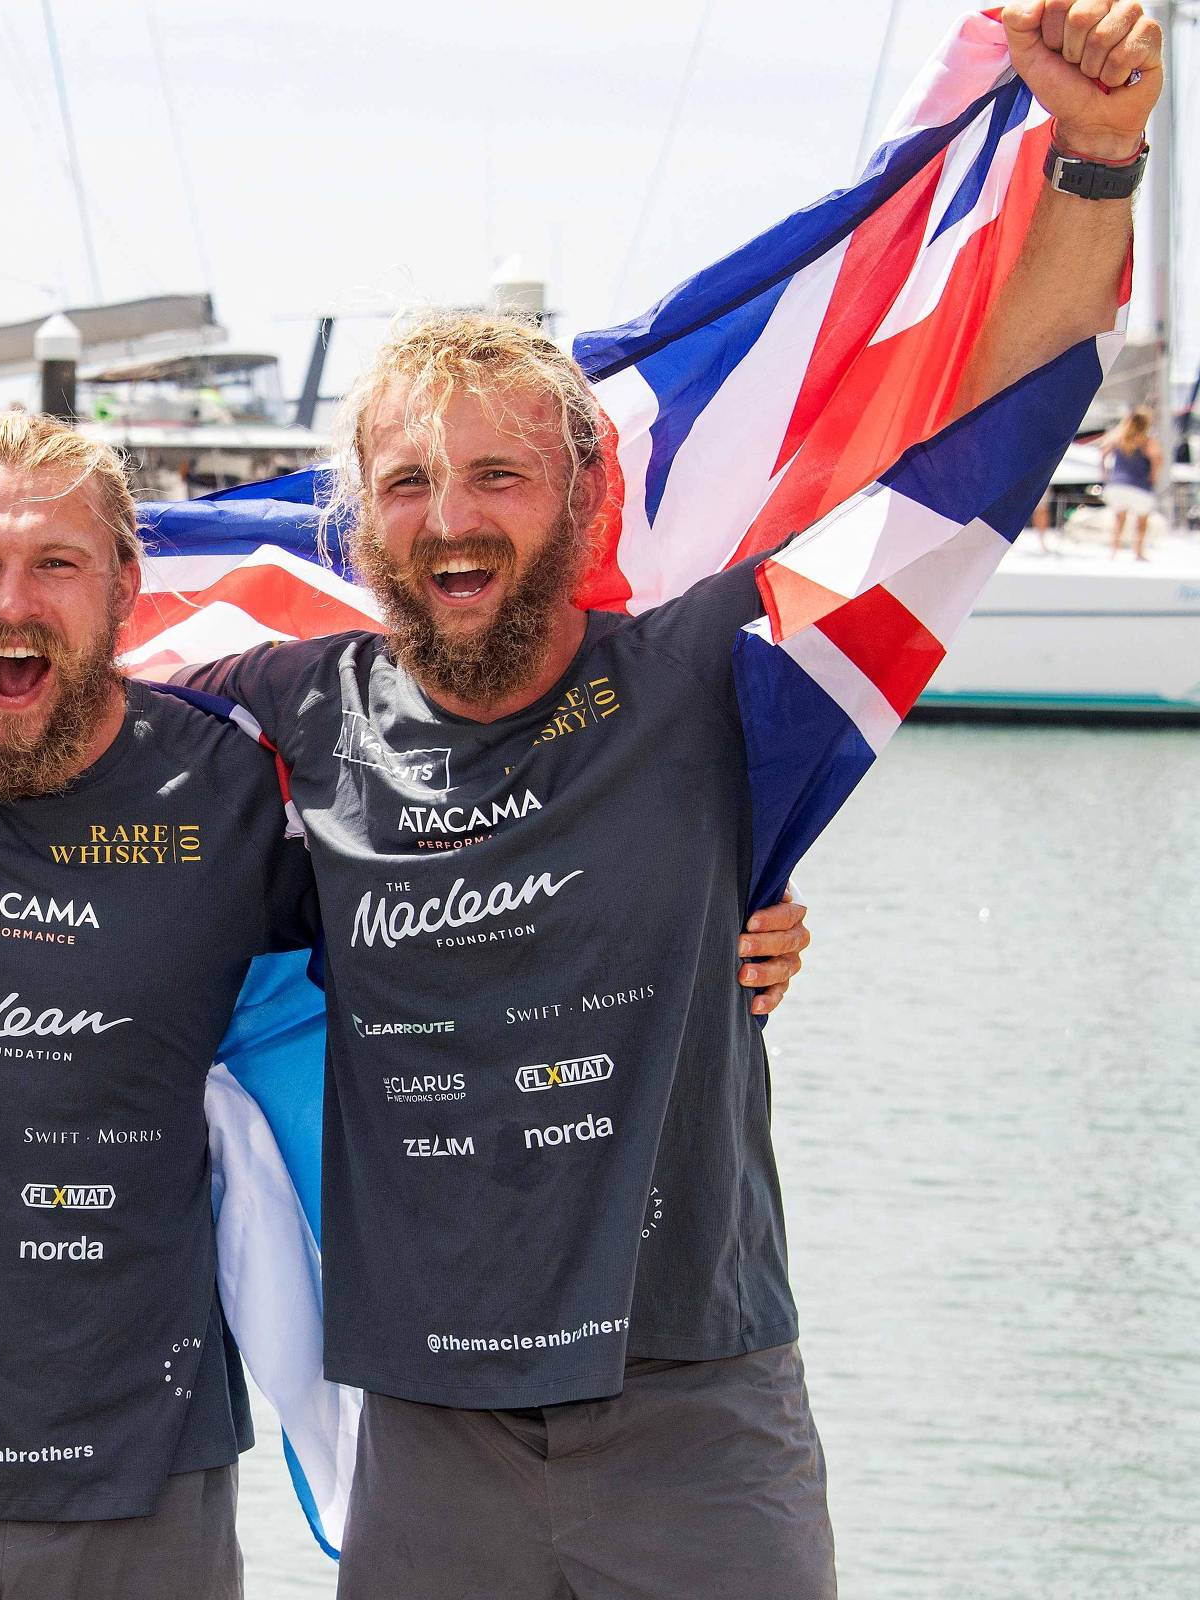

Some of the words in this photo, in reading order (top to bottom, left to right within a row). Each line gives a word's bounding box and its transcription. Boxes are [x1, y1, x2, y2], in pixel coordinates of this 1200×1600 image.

[398, 789, 542, 833] ATACAMA
[90, 825, 168, 843] RARE
[179, 825, 201, 863] 101
[417, 834, 494, 849] PERFORM
[49, 845, 168, 864] WHISKY
[386, 881, 411, 893] THE
[351, 870, 584, 949] Maclean
[436, 924, 536, 949] FOUNDATION
[506, 1004, 562, 1025] SWIFT
[581, 984, 655, 1012] MORRIS
[390, 1073, 466, 1093] CLARUS
[522, 1059, 605, 1088] FLXMAT
[434, 1092, 467, 1102] GROUP
[23, 1127, 80, 1144] SWIFT
[98, 1128, 162, 1144] MORRIS
[524, 1114, 614, 1149] norda
[402, 1134, 475, 1157] ZELIM
[29, 1187, 109, 1206] FLXMAT
[19, 1236, 104, 1260] norda
[427, 1316, 630, 1353] @themacleanbrothers
